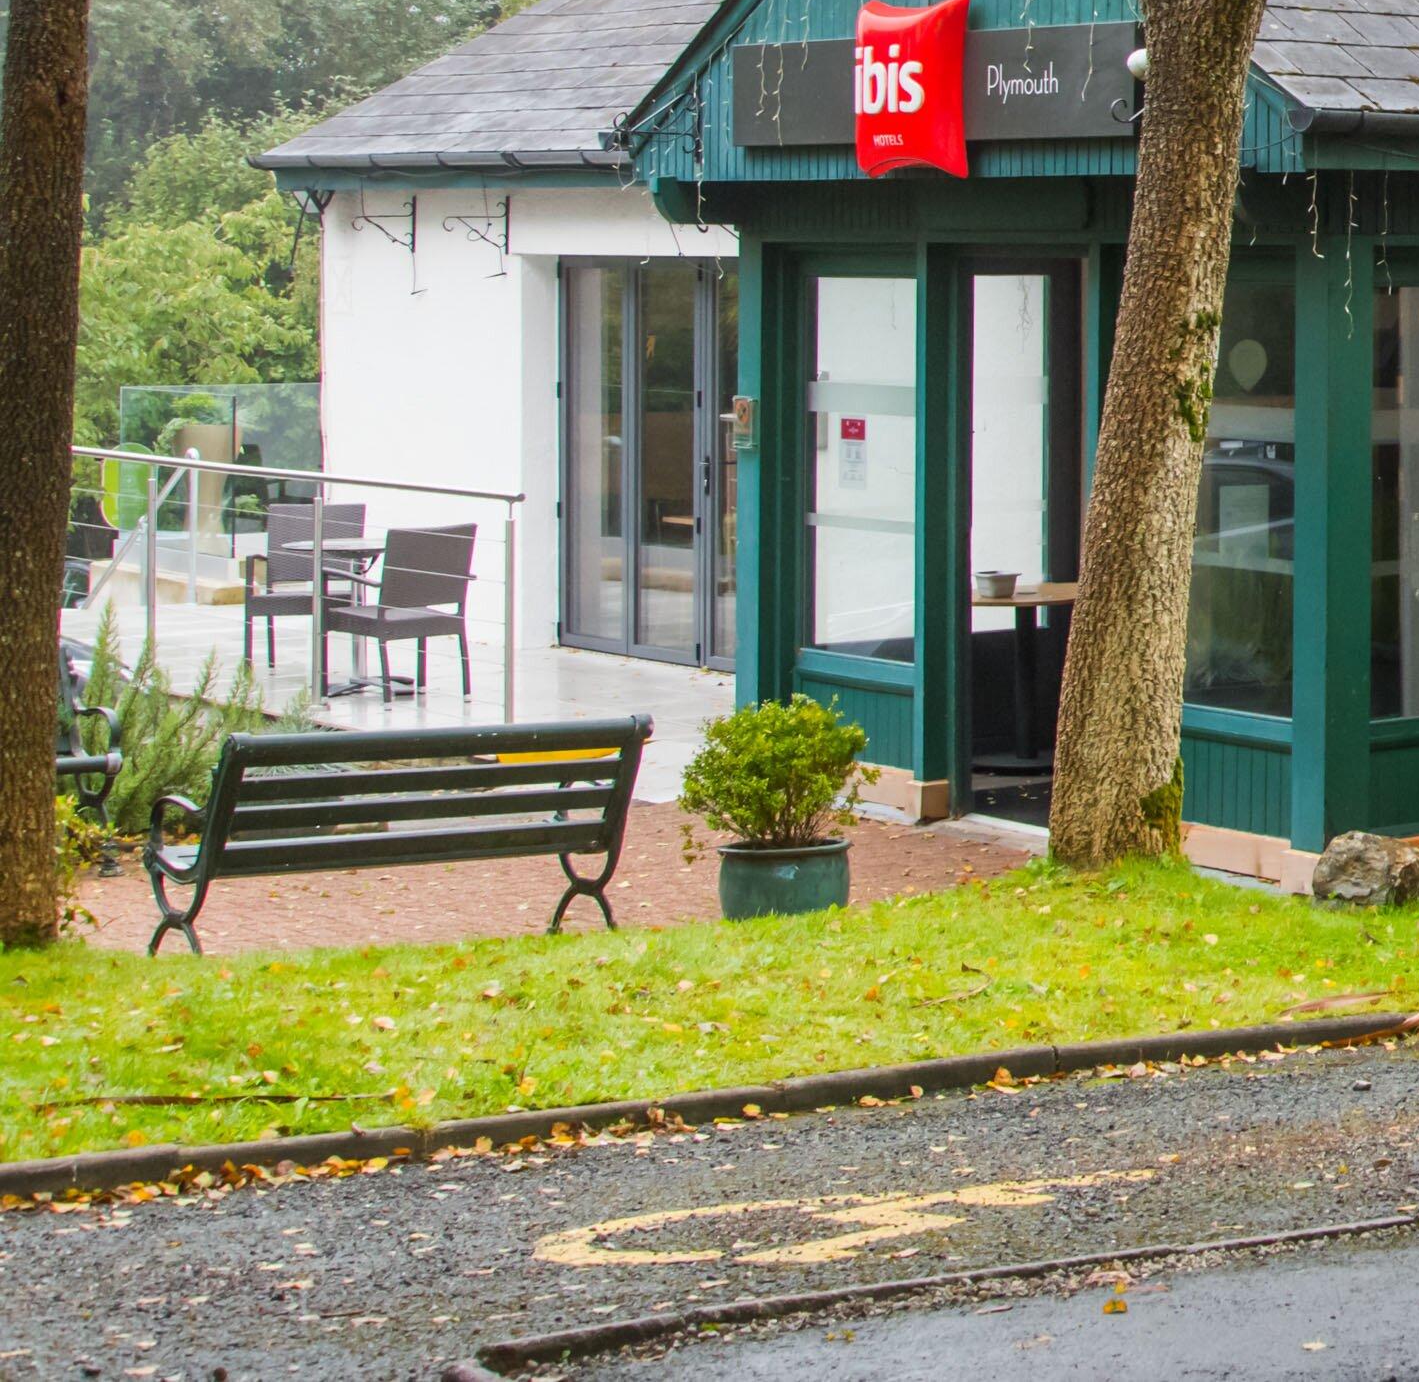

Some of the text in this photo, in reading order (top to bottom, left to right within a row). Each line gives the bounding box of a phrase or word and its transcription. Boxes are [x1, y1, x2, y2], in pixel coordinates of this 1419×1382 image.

[855, 44, 925, 114] ibis
[987, 61, 1059, 104] Plymouth
[873, 134, 904, 147] HOTELS
